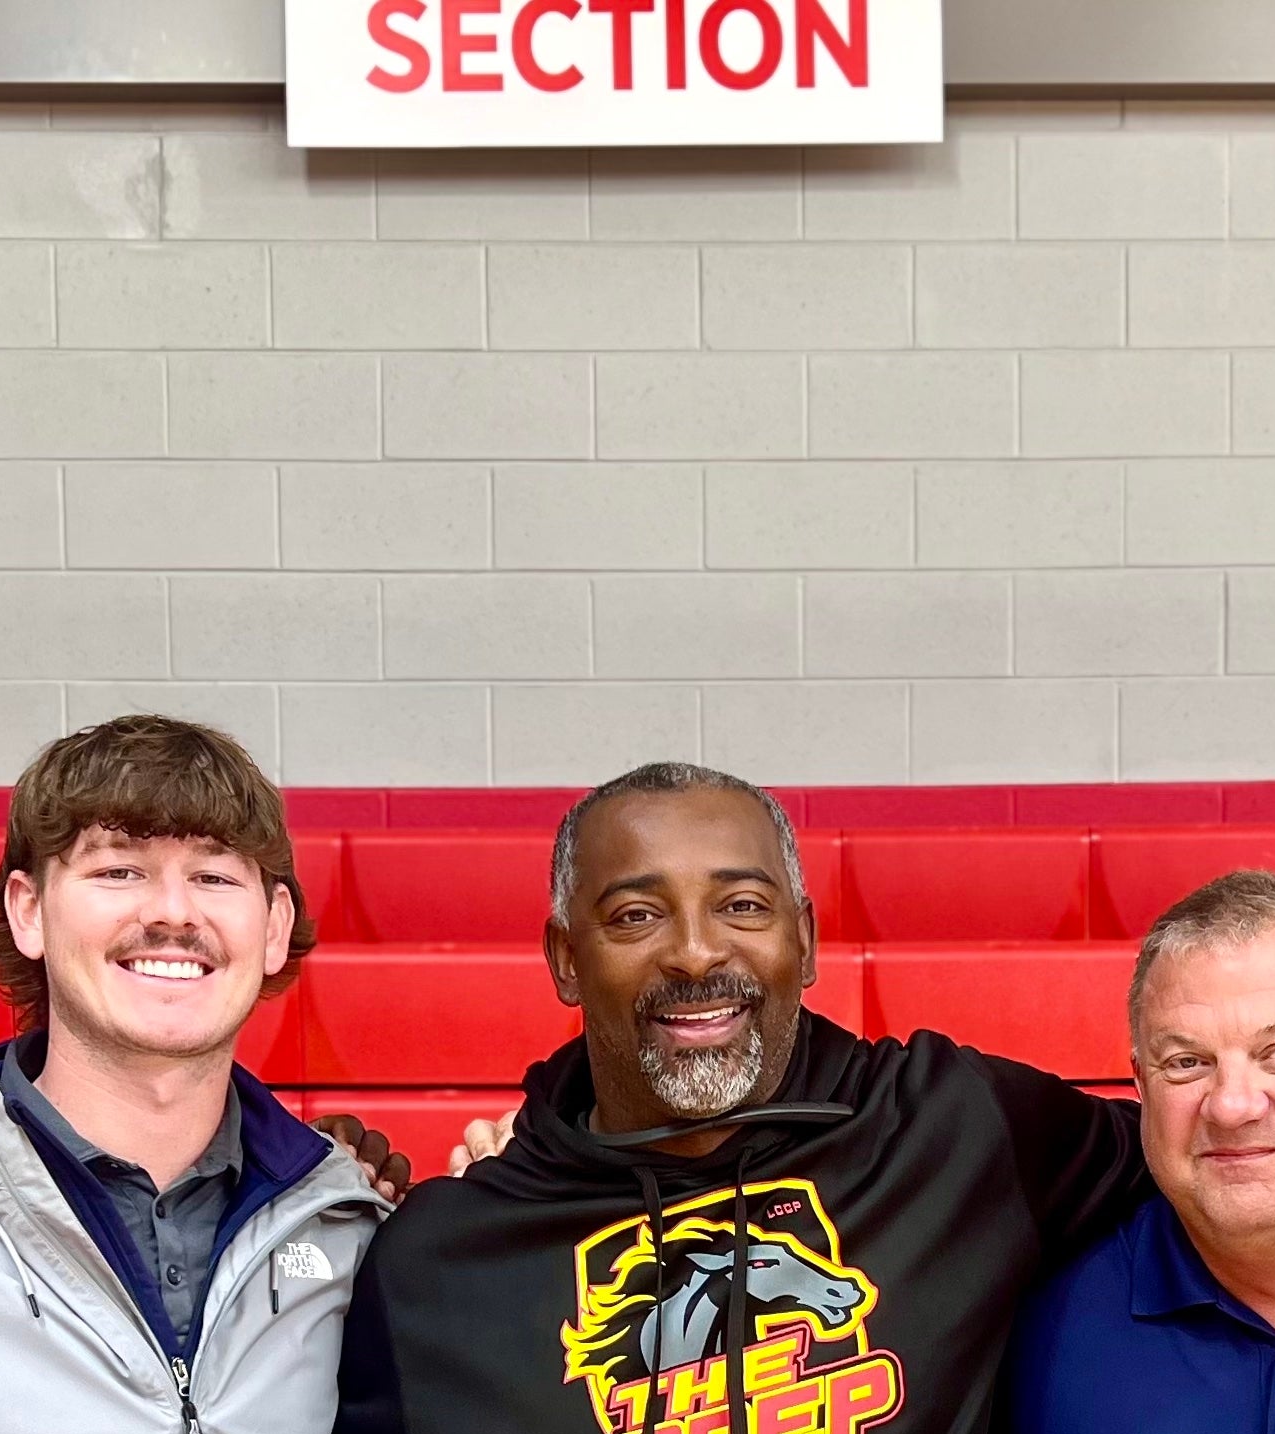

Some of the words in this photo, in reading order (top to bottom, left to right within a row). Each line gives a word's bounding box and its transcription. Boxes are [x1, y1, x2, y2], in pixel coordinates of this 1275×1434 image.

[365, 0, 869, 93] SECTION
[284, 1265, 315, 1279] FACE
[286, 1242, 312, 1255] THE
[610, 1335, 802, 1428] THE
